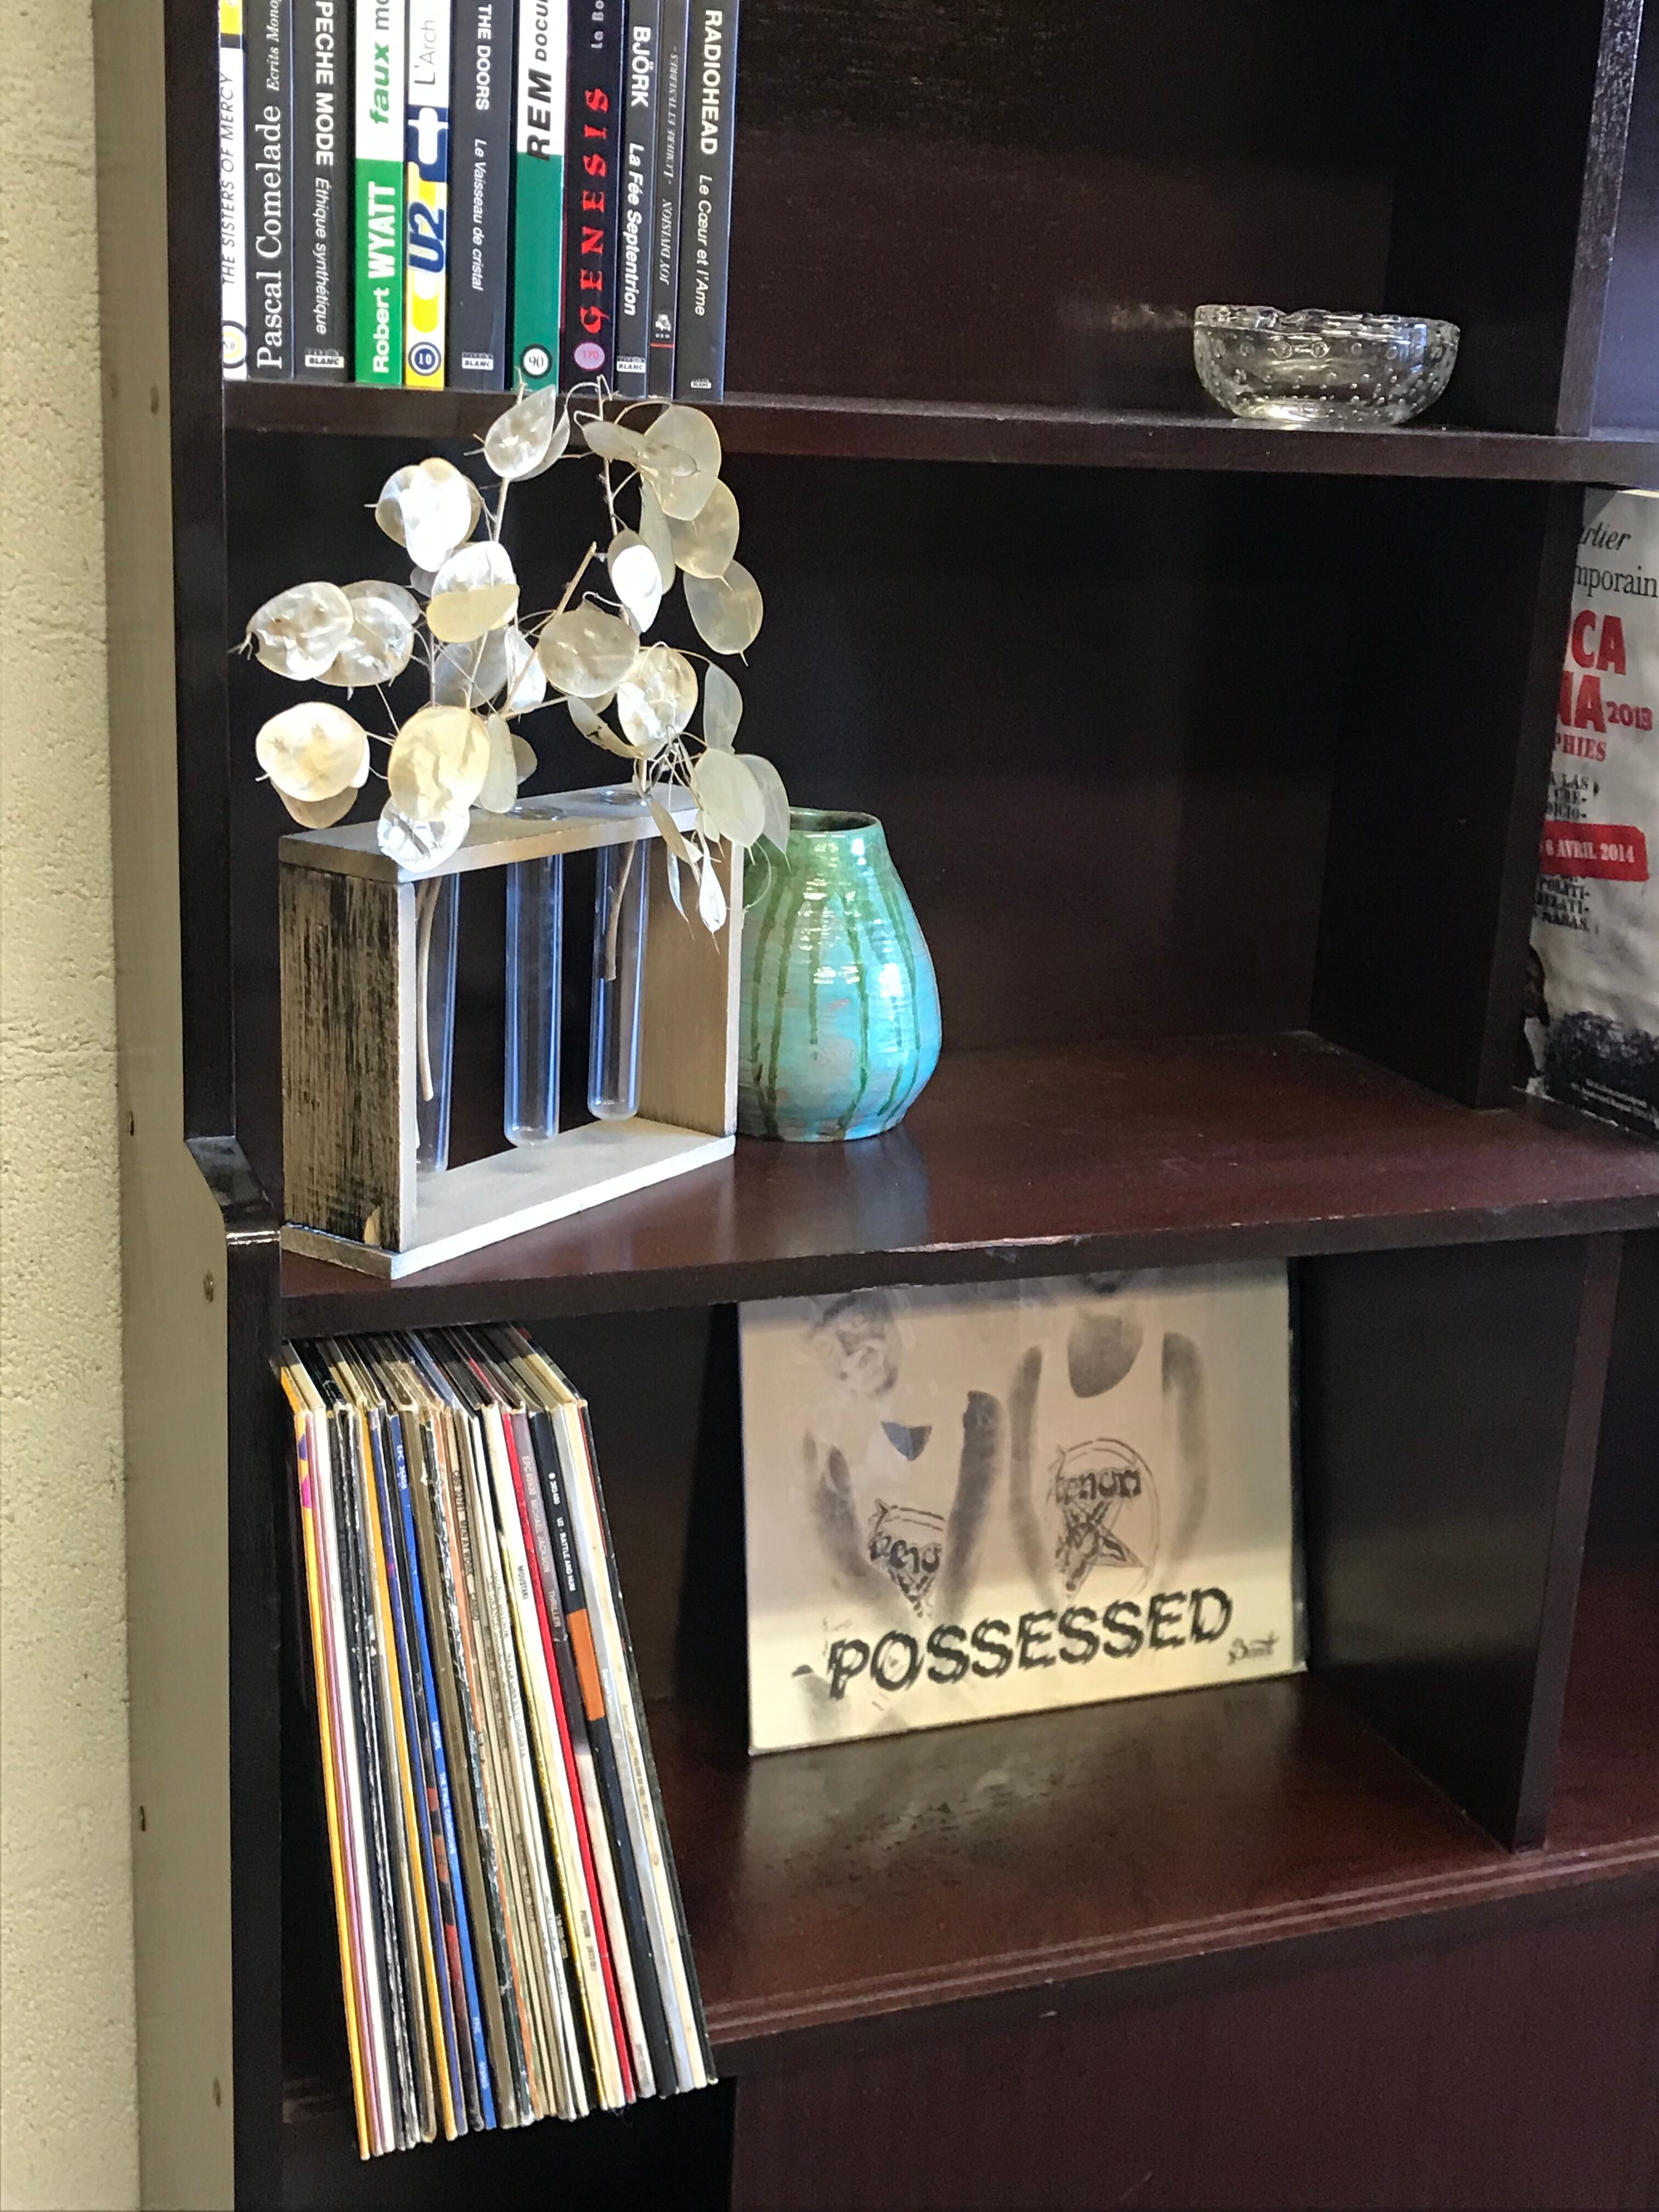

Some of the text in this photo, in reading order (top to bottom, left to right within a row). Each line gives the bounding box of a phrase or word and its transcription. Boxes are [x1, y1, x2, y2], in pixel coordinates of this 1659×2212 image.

[315, 0, 334, 86] PECHE
[414, 20, 437, 85] L'Arch
[369, 41, 390, 124] faux
[527, 0, 553, 161] REM DOCU
[699, 10, 722, 155] RADIOHEAD
[315, 93, 334, 166] MODE
[471, 4, 492, 291] THE DOORS Le Vaisseau de cristal
[219, 72, 235, 285] THE SISTERS OF MERCY
[255, 0, 283, 370] Pascal Comelade Ecrits Mono
[622, 26, 654, 316] BJÖRK La Fée Septentrion
[699, 174, 712, 195] Le
[314, 177, 331, 238] Éthique
[408, 200, 445, 274] U2
[580, 88, 610, 334] GENESIS
[660, 198, 673, 259] DIVISION
[313, 242, 331, 335] synthétique
[368, 181, 395, 374] Robert WYATT
[659, 259, 670, 286] JOY
[696, 250, 709, 266] et
[308, 357, 341, 366] BLANC
[419, 352, 432, 366] 10
[528, 356, 544, 368] 90
[582, 351, 599, 359] 170
[1606, 701, 1653, 731] 2013
[1556, 839, 1598, 860] AVRIL
[1600, 842, 1635, 864] 2014
[557, 1517, 564, 1527] U2
[560, 1532, 571, 1560] RATTLE
[565, 1560, 573, 1575] AND
[567, 1575, 577, 1592] HUM
[547, 1591, 561, 1628] THRILLER
[827, 1587, 1233, 1700] POSSESSED
